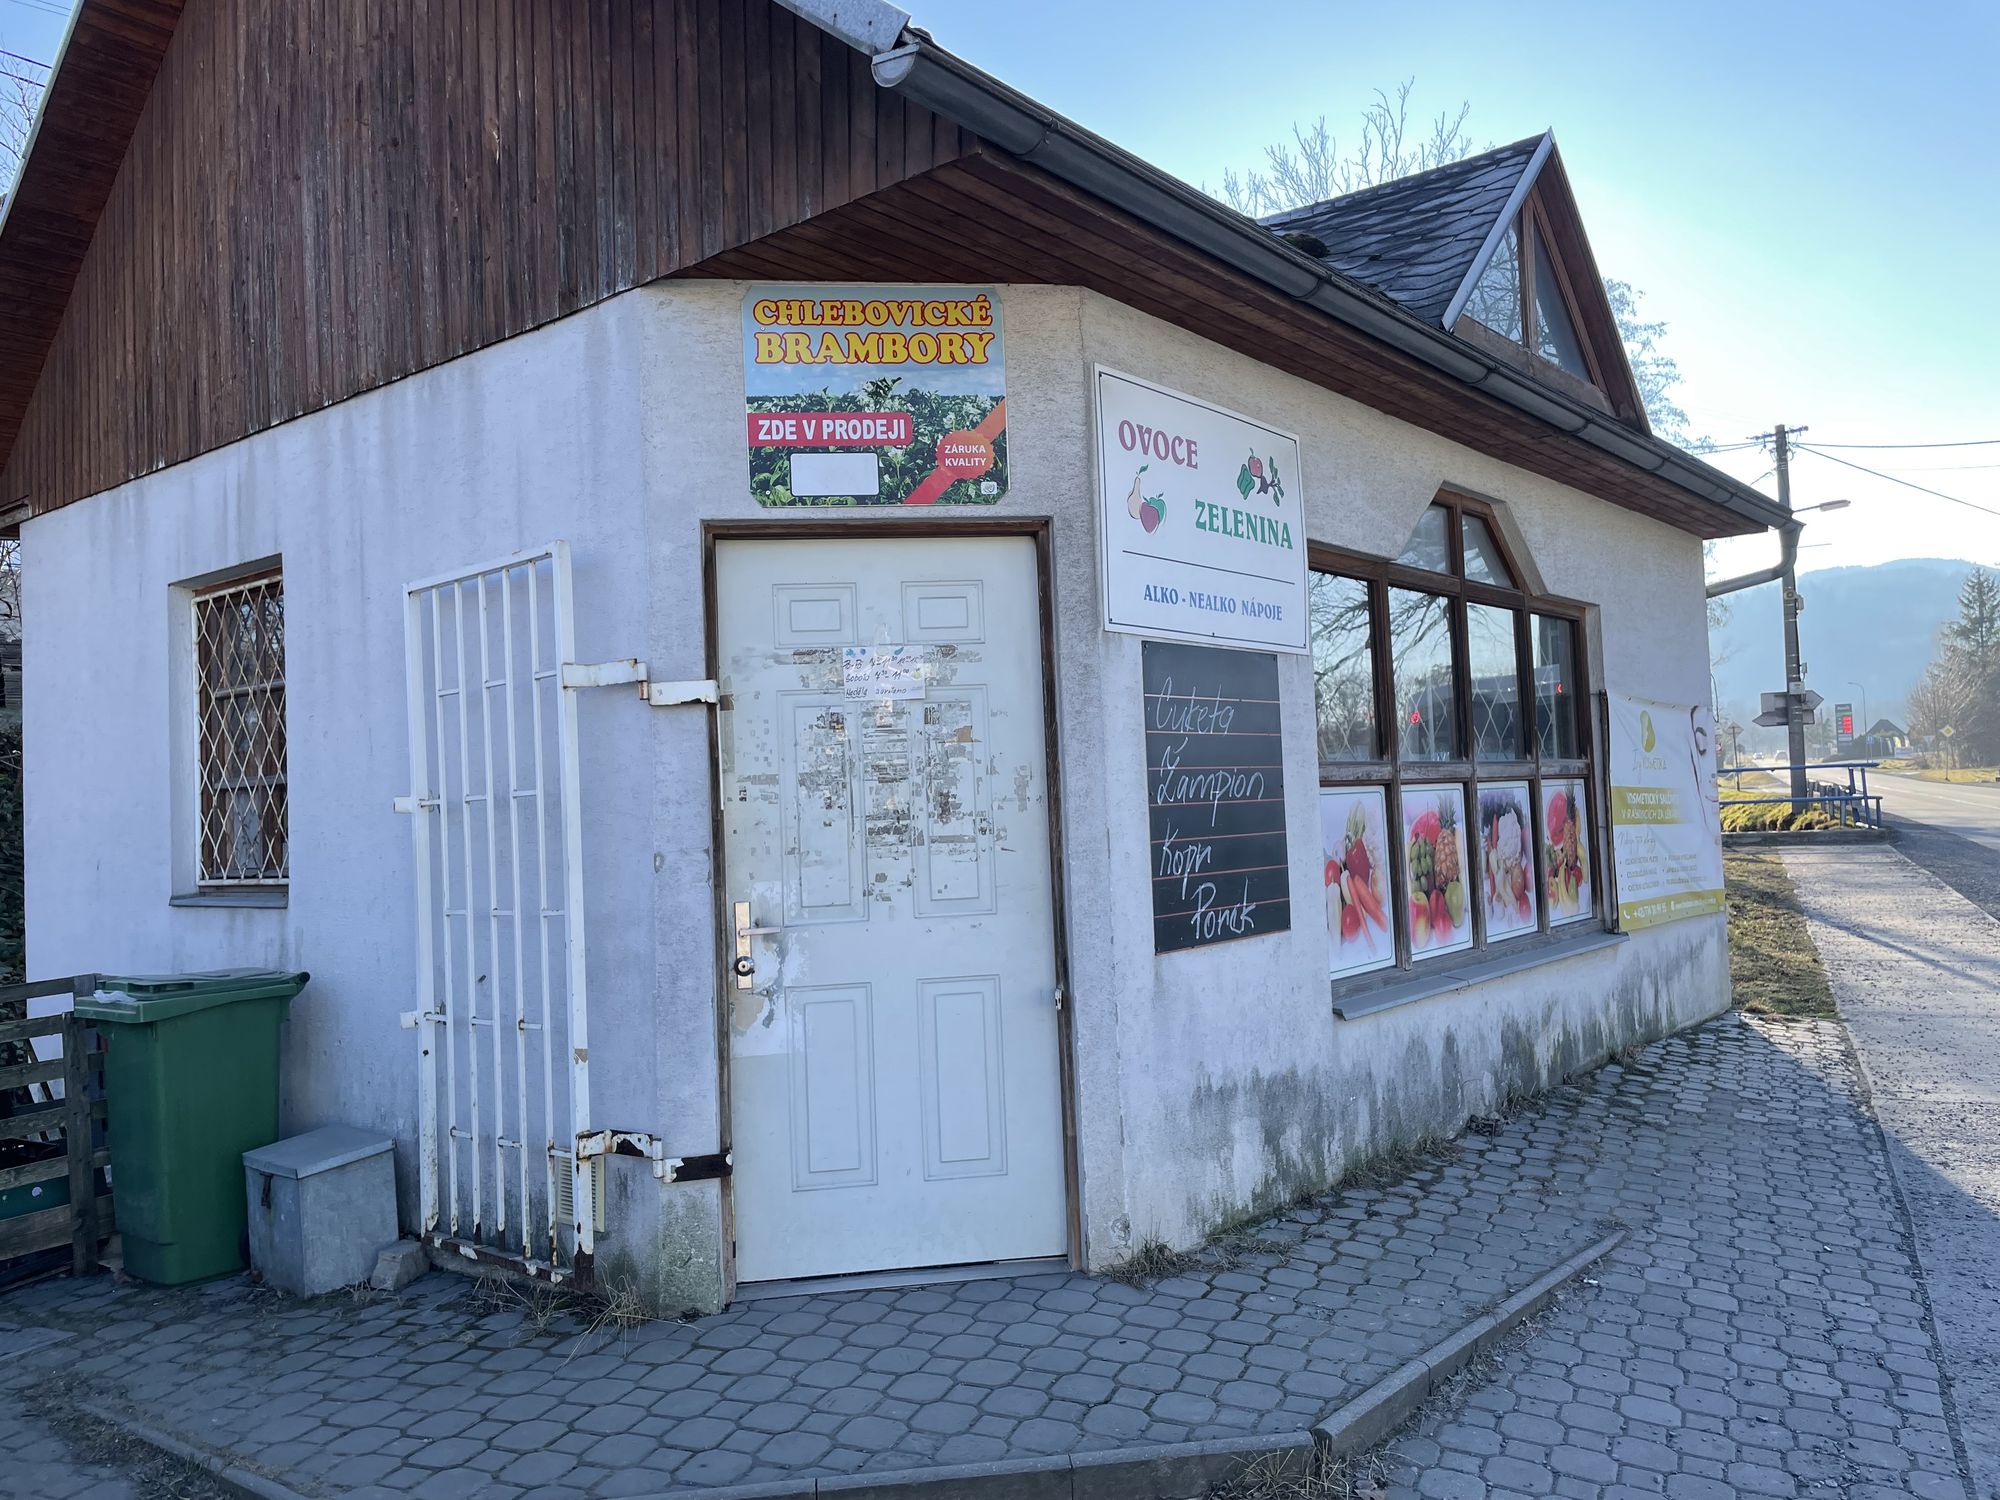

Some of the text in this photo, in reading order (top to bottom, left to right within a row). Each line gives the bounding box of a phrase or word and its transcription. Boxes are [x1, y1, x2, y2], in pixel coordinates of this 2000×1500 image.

[752, 293, 993, 326] CHLEBOVICKÉ
[754, 331, 995, 364] BRAMBORY
[758, 418, 905, 440] ZDE V PRODEJI
[1118, 419, 1199, 470] OVOCE
[944, 442, 986, 454] ZÁRUKA
[945, 457, 986, 467] KVALITY
[1194, 499, 1293, 550] ZELENINA
[1143, 584, 1179, 605] ALKO
[1189, 591, 1236, 614] NEALKO
[1241, 597, 1282, 621] NÁPOJE
[1156, 676, 1235, 736] Cuketa
[1157, 737, 1264, 827] Žampion
